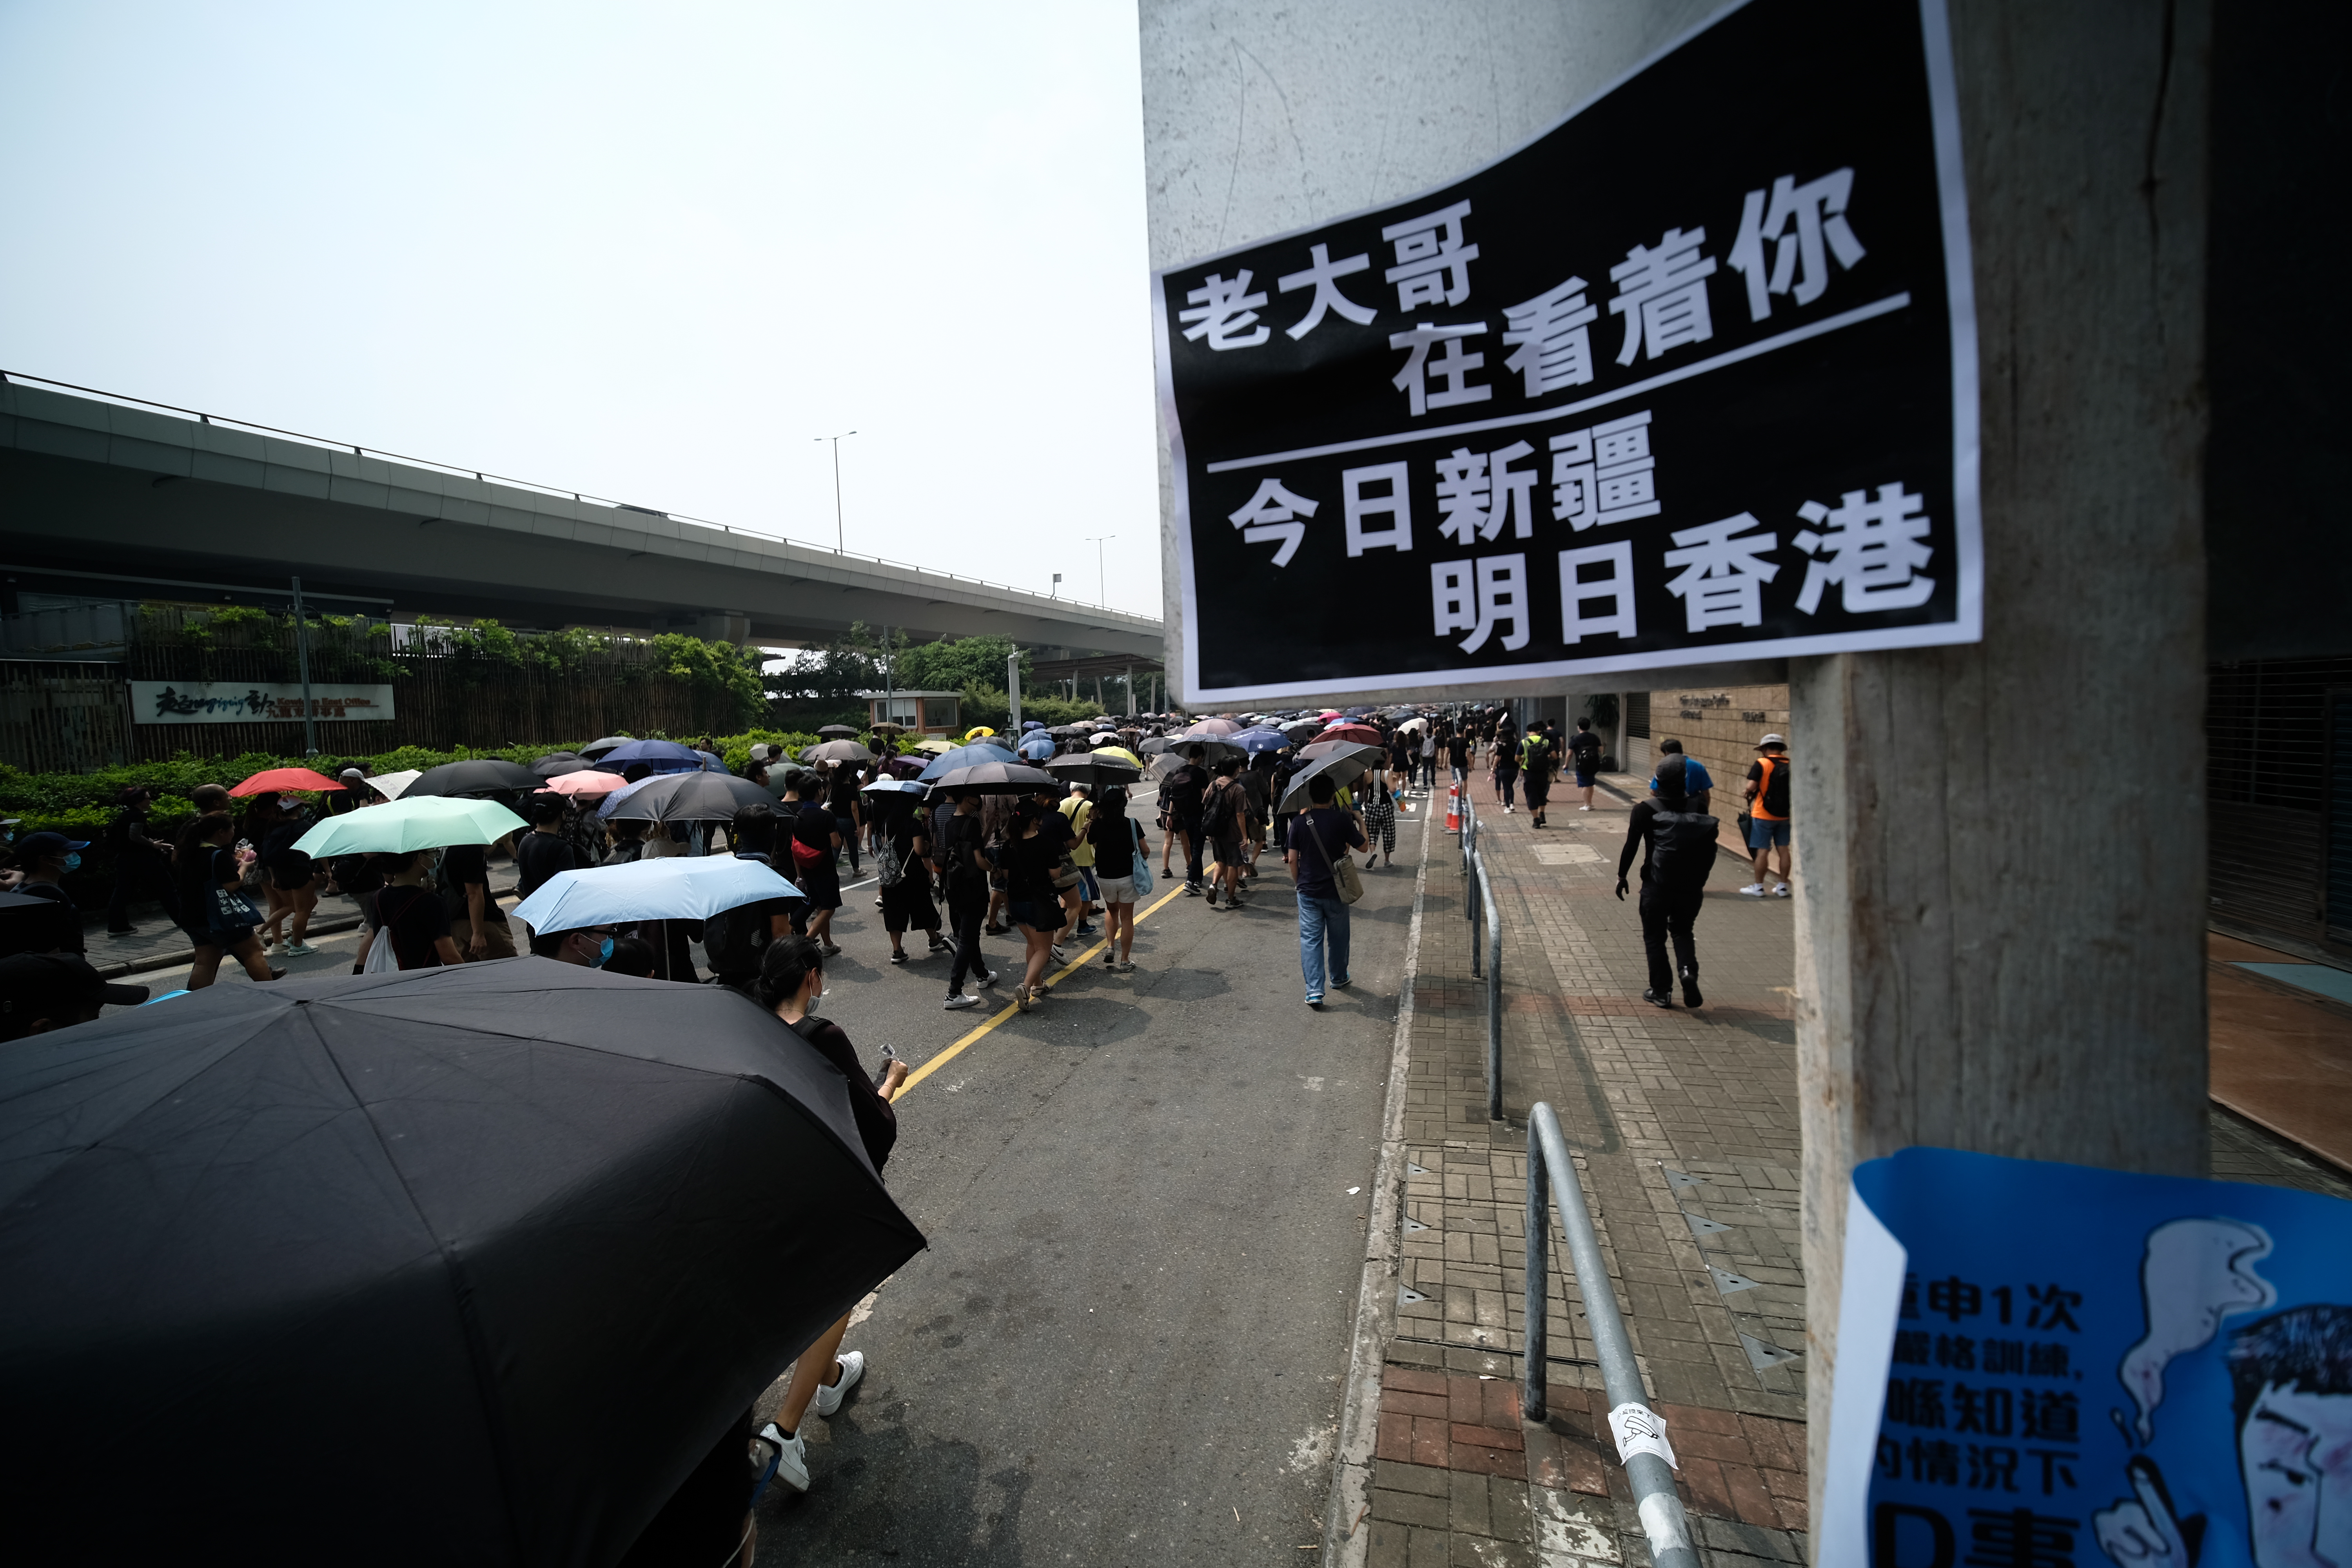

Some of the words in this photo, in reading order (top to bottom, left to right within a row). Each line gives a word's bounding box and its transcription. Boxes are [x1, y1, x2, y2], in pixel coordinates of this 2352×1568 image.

[1179, 200, 1481, 351] 老大哥
[1389, 168, 1867, 416] 在看着你
[1229, 411, 1660, 567] 今日新疆
[1430, 482, 1935, 654] 明日香港
